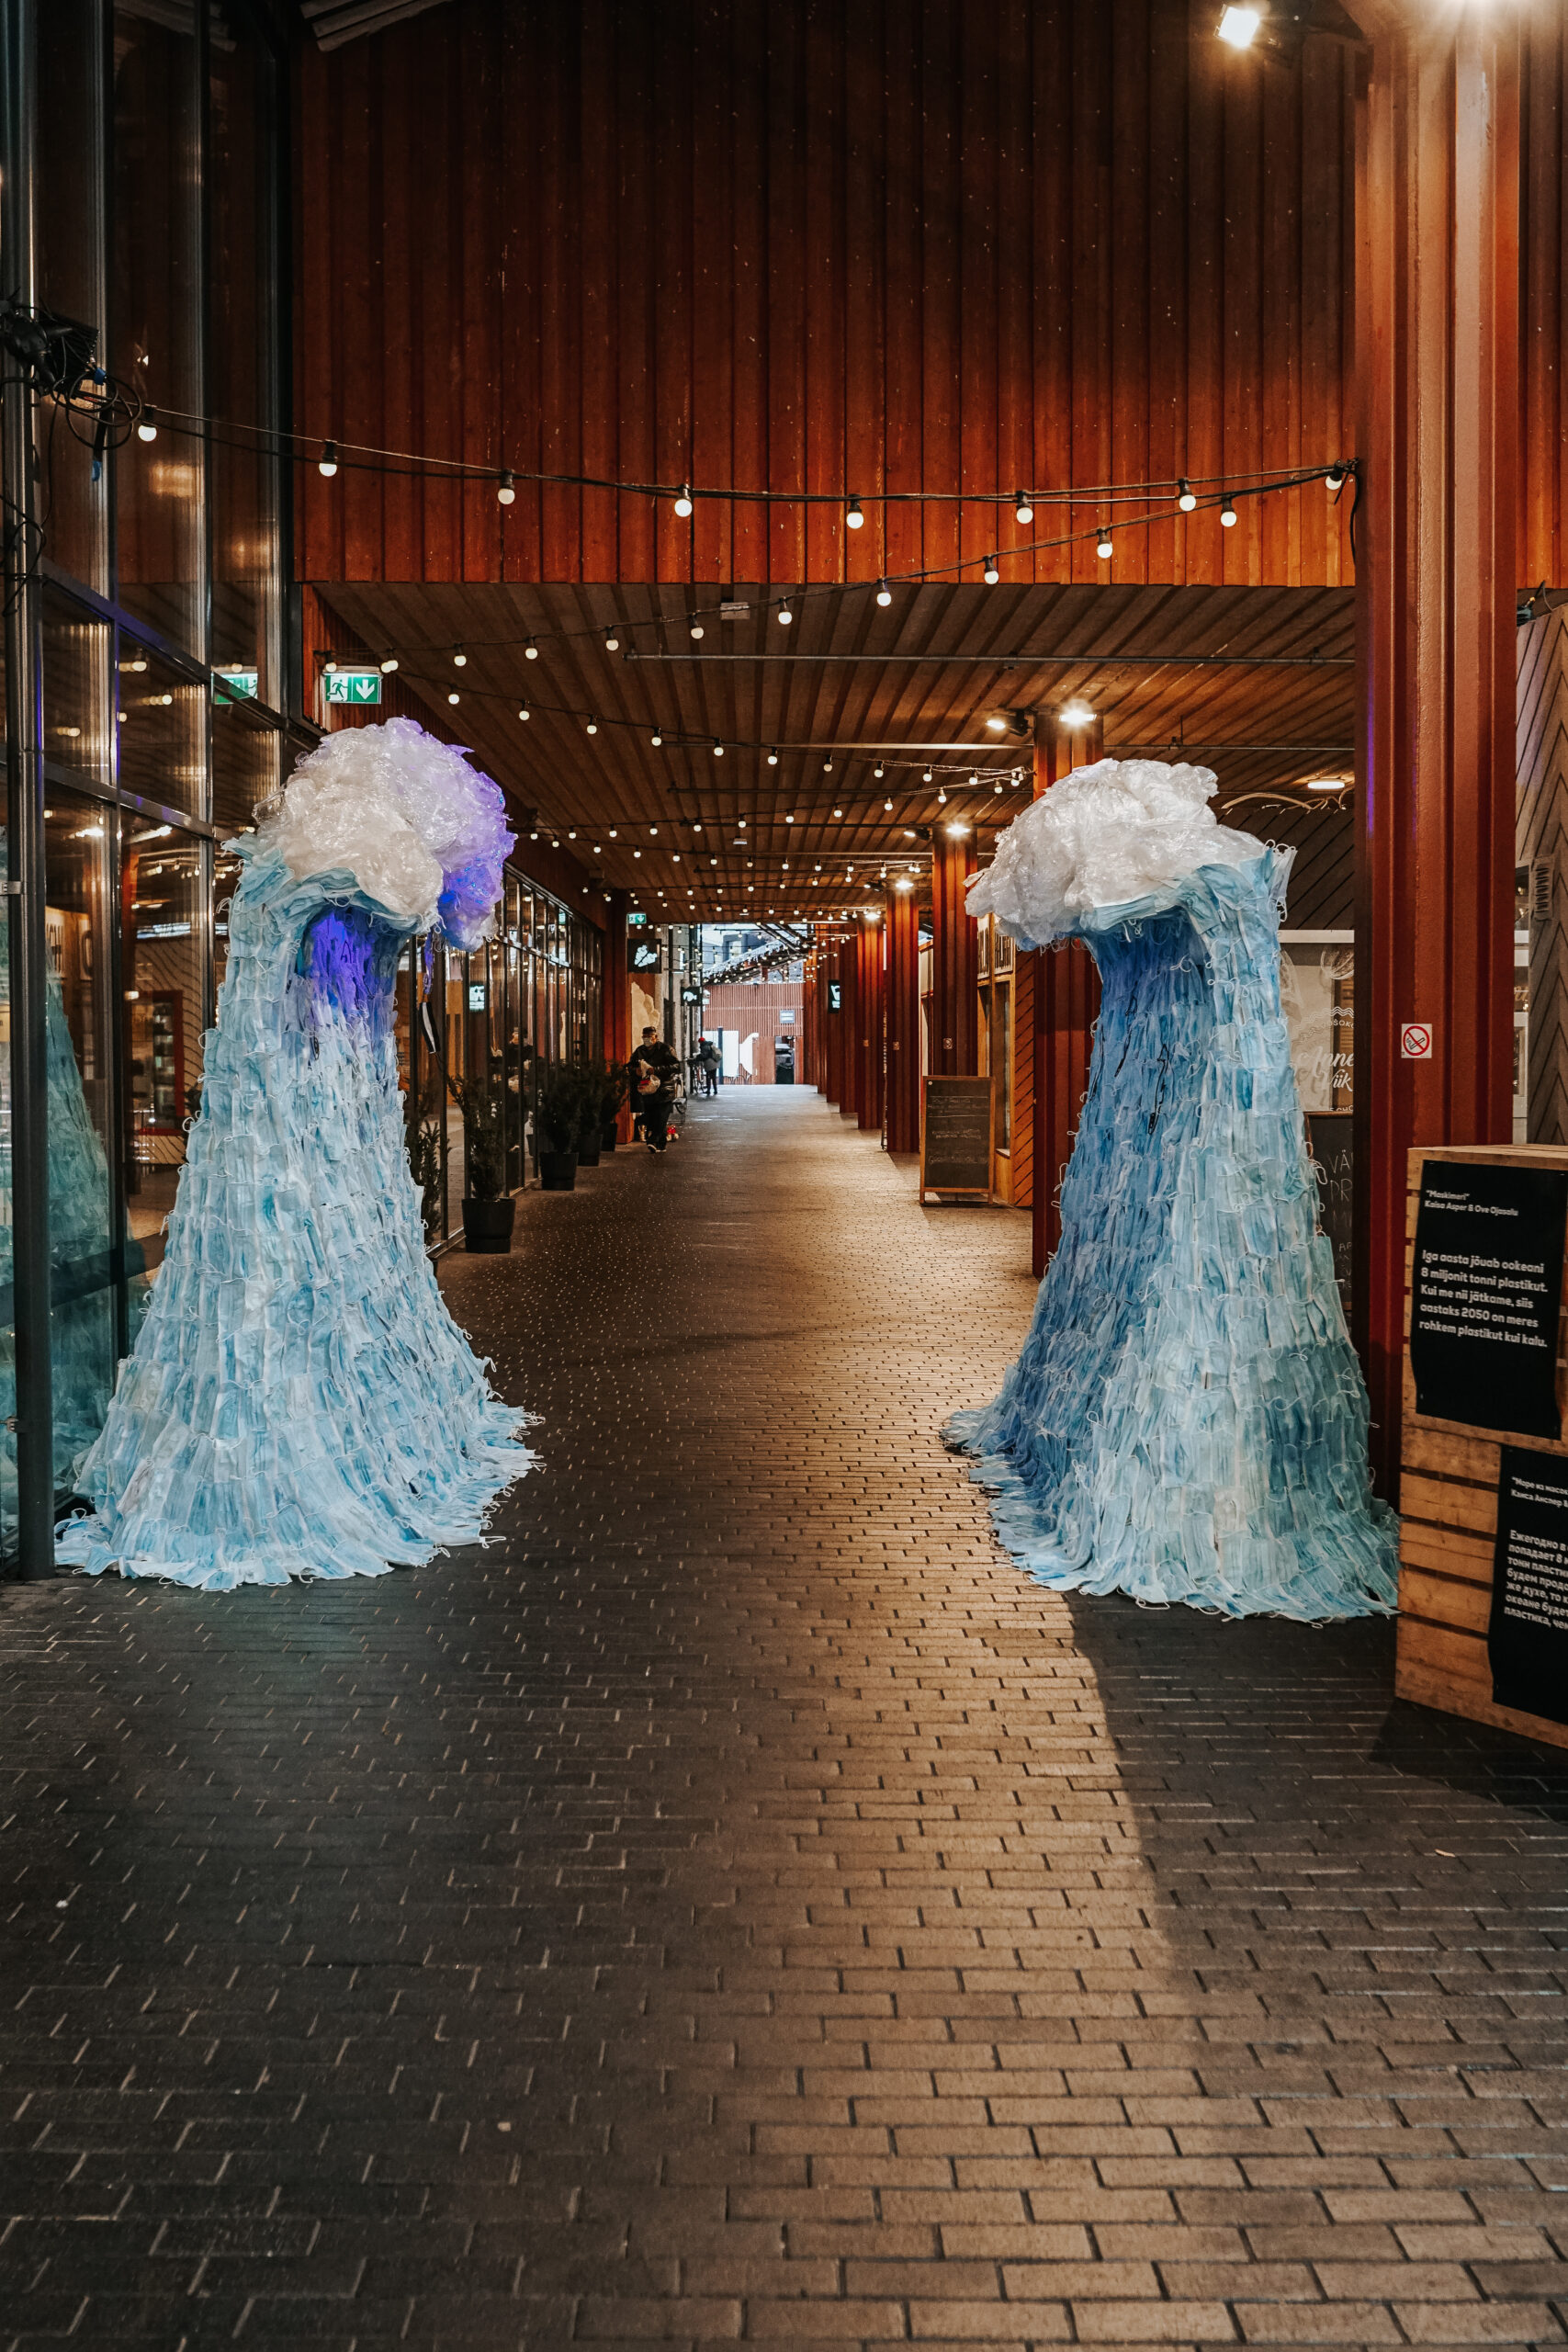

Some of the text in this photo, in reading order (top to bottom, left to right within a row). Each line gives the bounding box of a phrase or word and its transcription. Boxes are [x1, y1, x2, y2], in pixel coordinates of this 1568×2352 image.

[1425, 1200, 1446, 1209] Kaisa
[1446, 1202, 1467, 1212] Asper
[1474, 1204, 1489, 1214] Ove
[1490, 1206, 1518, 1216] Ojasalu
[1422, 1250, 1544, 1273] Iga aasta jõuab ookeani
[1421, 1267, 1548, 1293] 8 miljonit tonni plastikut.
[1420, 1284, 1534, 1308] Kui me nii jätkame, siis
[1420, 1303, 1539, 1328] aastaks 2050 on meres
[1419, 1319, 1548, 1348] rohkem plastikut kui kalu.
[1510, 1529, 1566, 1551] Ежегодно в
[1508, 1544, 1554, 1562] попадает
[1556, 1554, 1562, 1564] 8
[1506, 1567, 1538, 1583] будем
[1506, 1581, 1521, 1592] же
[1522, 1586, 1549, 1600] духе,
[1550, 1592, 1562, 1601] то
[1506, 1594, 1540, 1610] океане
[1504, 1606, 1551, 1627] пластика,
